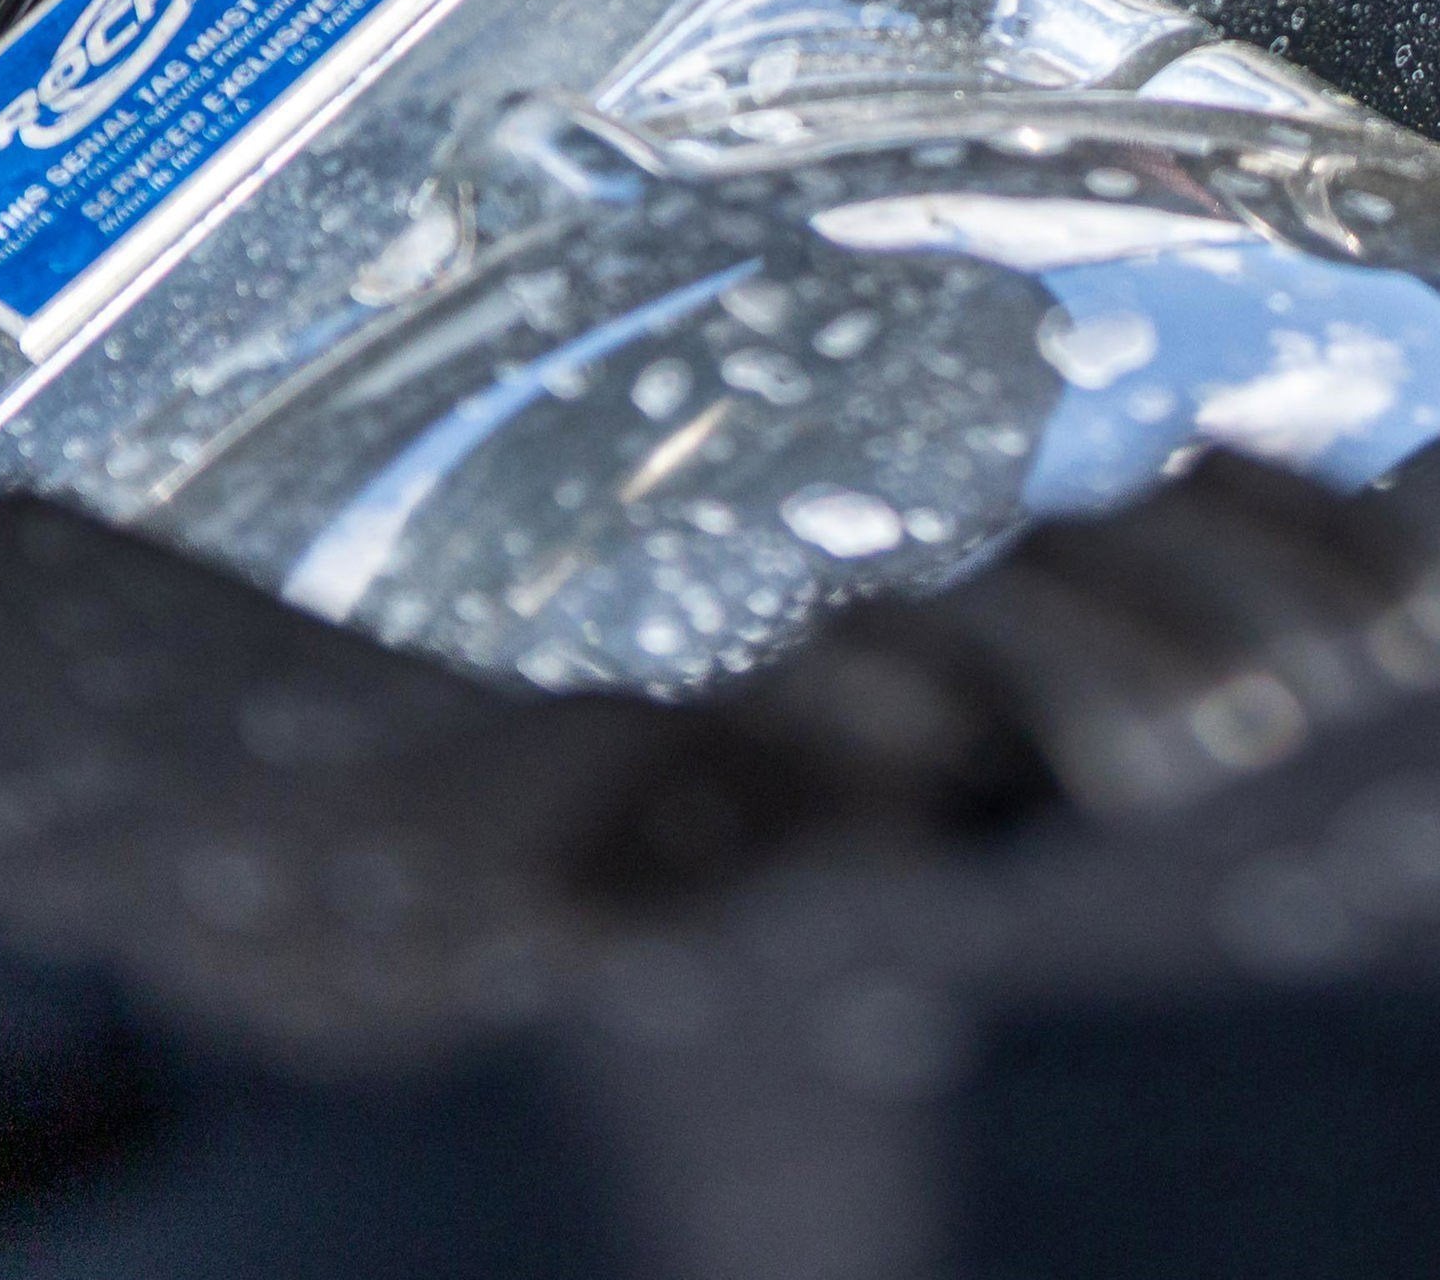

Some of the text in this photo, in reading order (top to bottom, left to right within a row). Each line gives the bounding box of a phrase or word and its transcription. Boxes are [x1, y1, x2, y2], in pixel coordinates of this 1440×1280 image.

[45, 109, 137, 186] SERIAL
[137, 59, 190, 105] TAG
[81, 110, 205, 218] SERVICED
